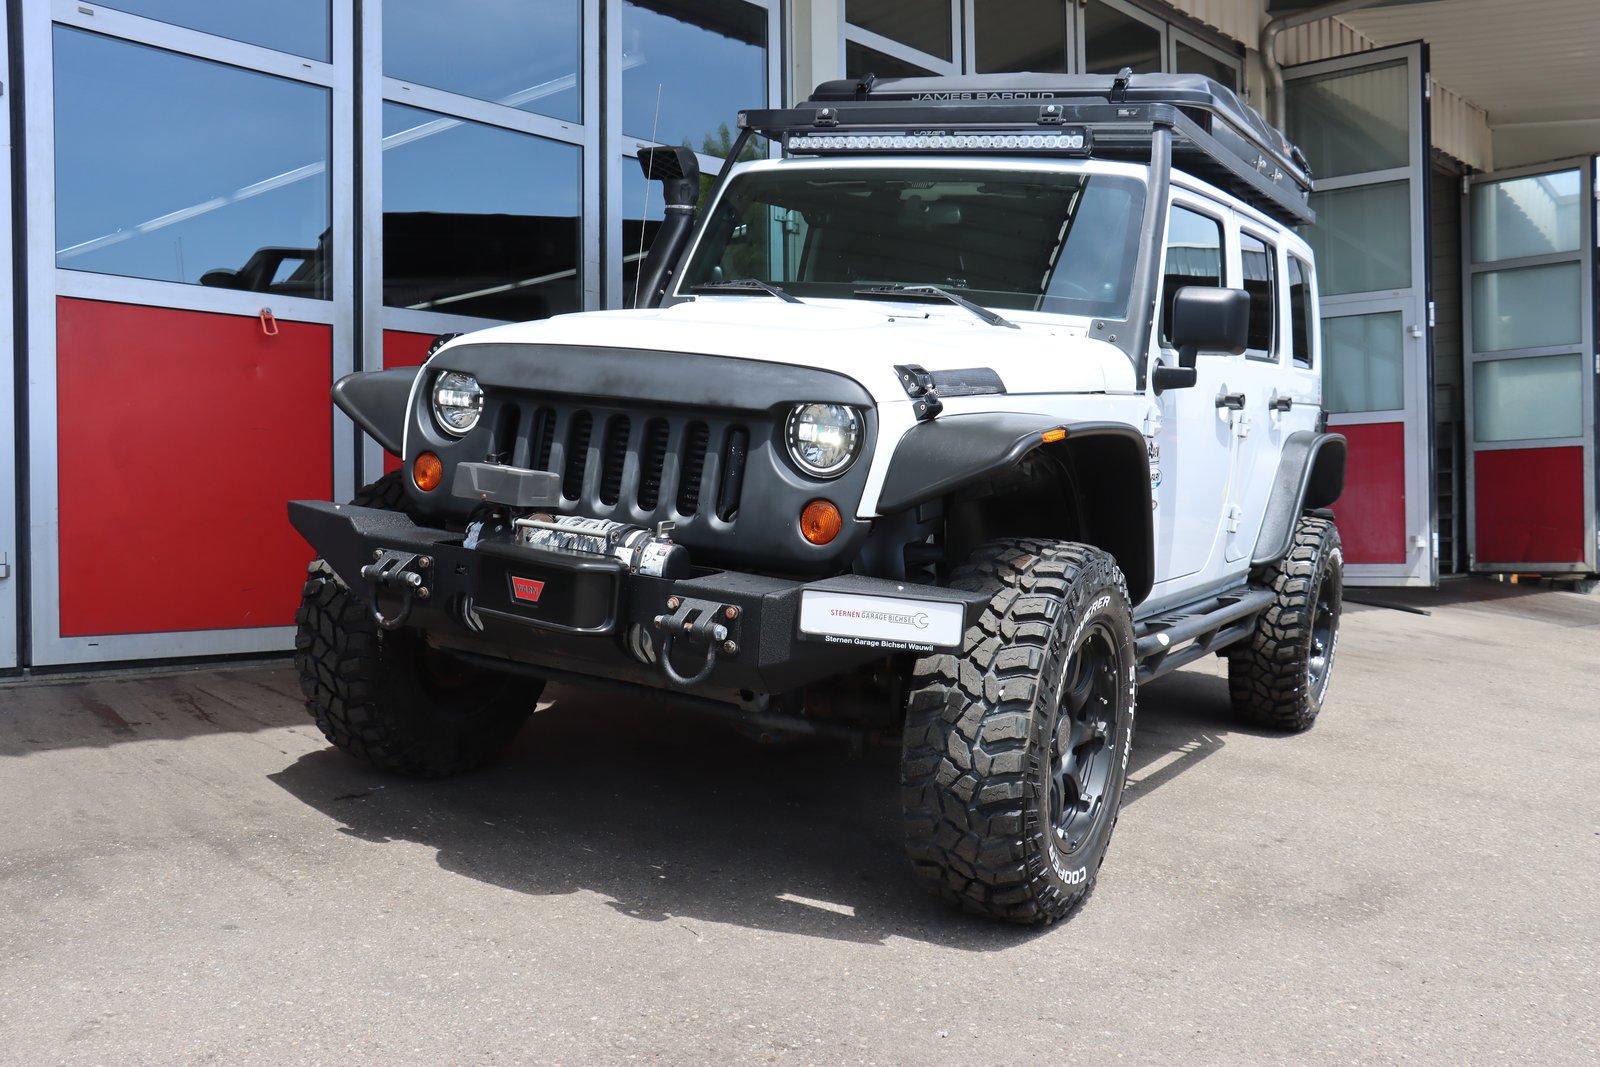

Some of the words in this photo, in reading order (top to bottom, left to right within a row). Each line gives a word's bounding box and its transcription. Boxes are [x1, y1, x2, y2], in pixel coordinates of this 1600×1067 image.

[911, 93, 972, 101] JAMES
[977, 92, 1055, 100] BAROUD
[516, 584, 539, 595] WARN
[830, 609, 860, 618] STERNEN
[861, 612, 888, 621] GARAGE
[888, 614, 915, 624] BICHSEL
[825, 635, 853, 644] Sternen
[853, 638, 880, 647] Garage
[881, 640, 907, 649] Bichsel
[908, 643, 934, 652] Wauwil
[1049, 843, 1087, 885] COOPER
